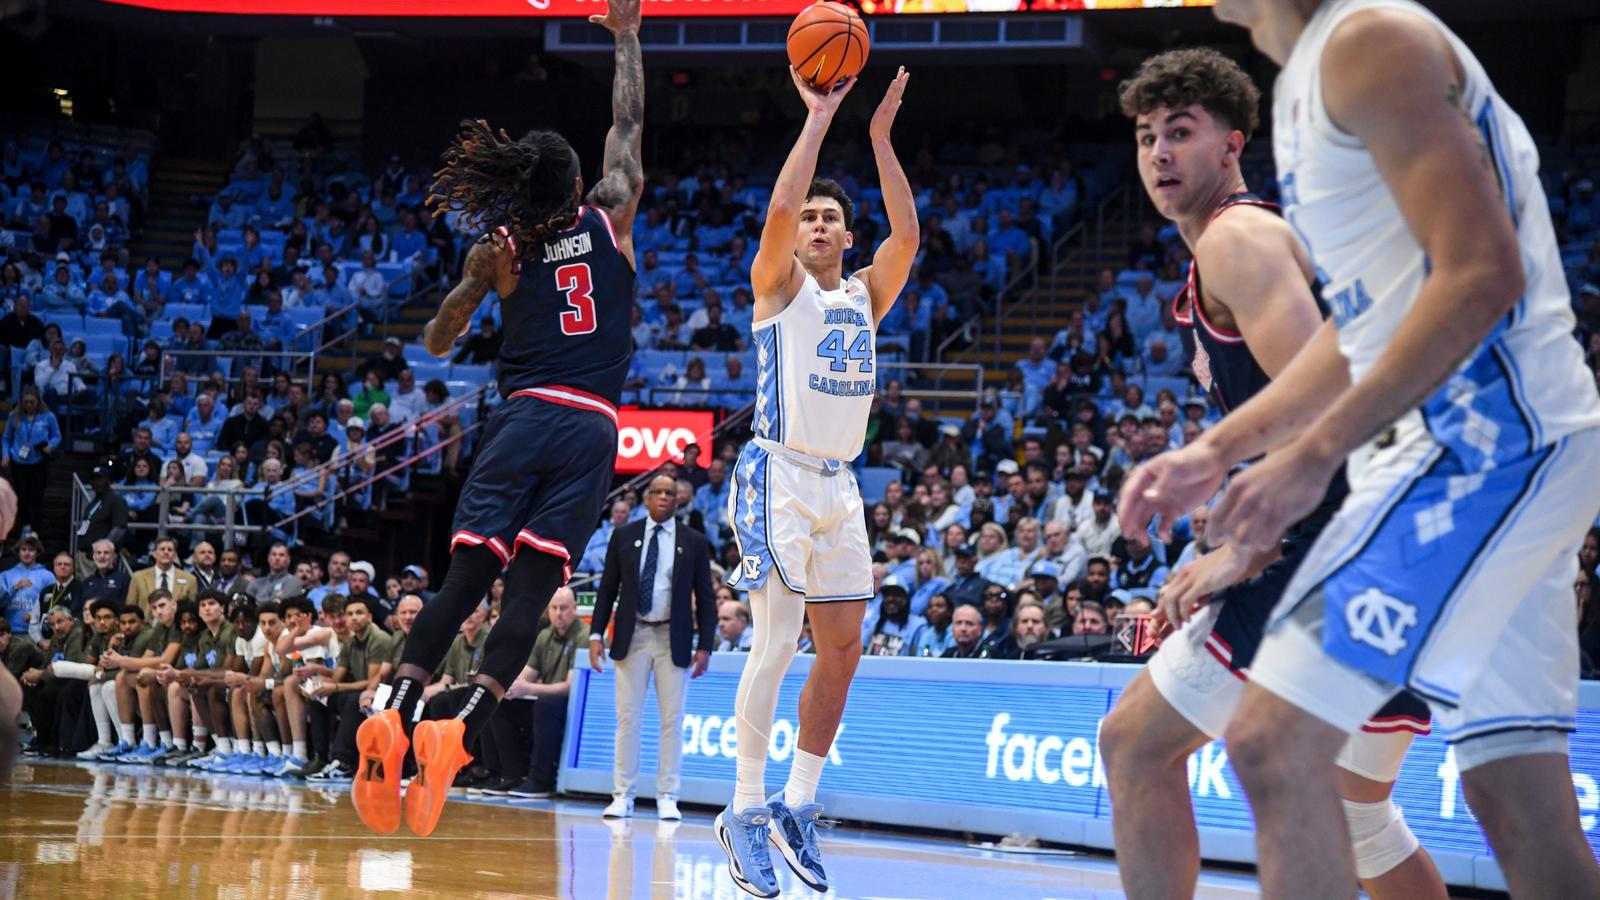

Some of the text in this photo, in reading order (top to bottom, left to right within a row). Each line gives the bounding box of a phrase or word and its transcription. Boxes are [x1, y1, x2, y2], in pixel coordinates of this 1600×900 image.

[542, 231, 593, 263] JOHNSON
[555, 262, 597, 336] 3
[816, 329, 873, 373] 44
[617, 426, 697, 460] ovo
[985, 712, 1232, 799] facek
